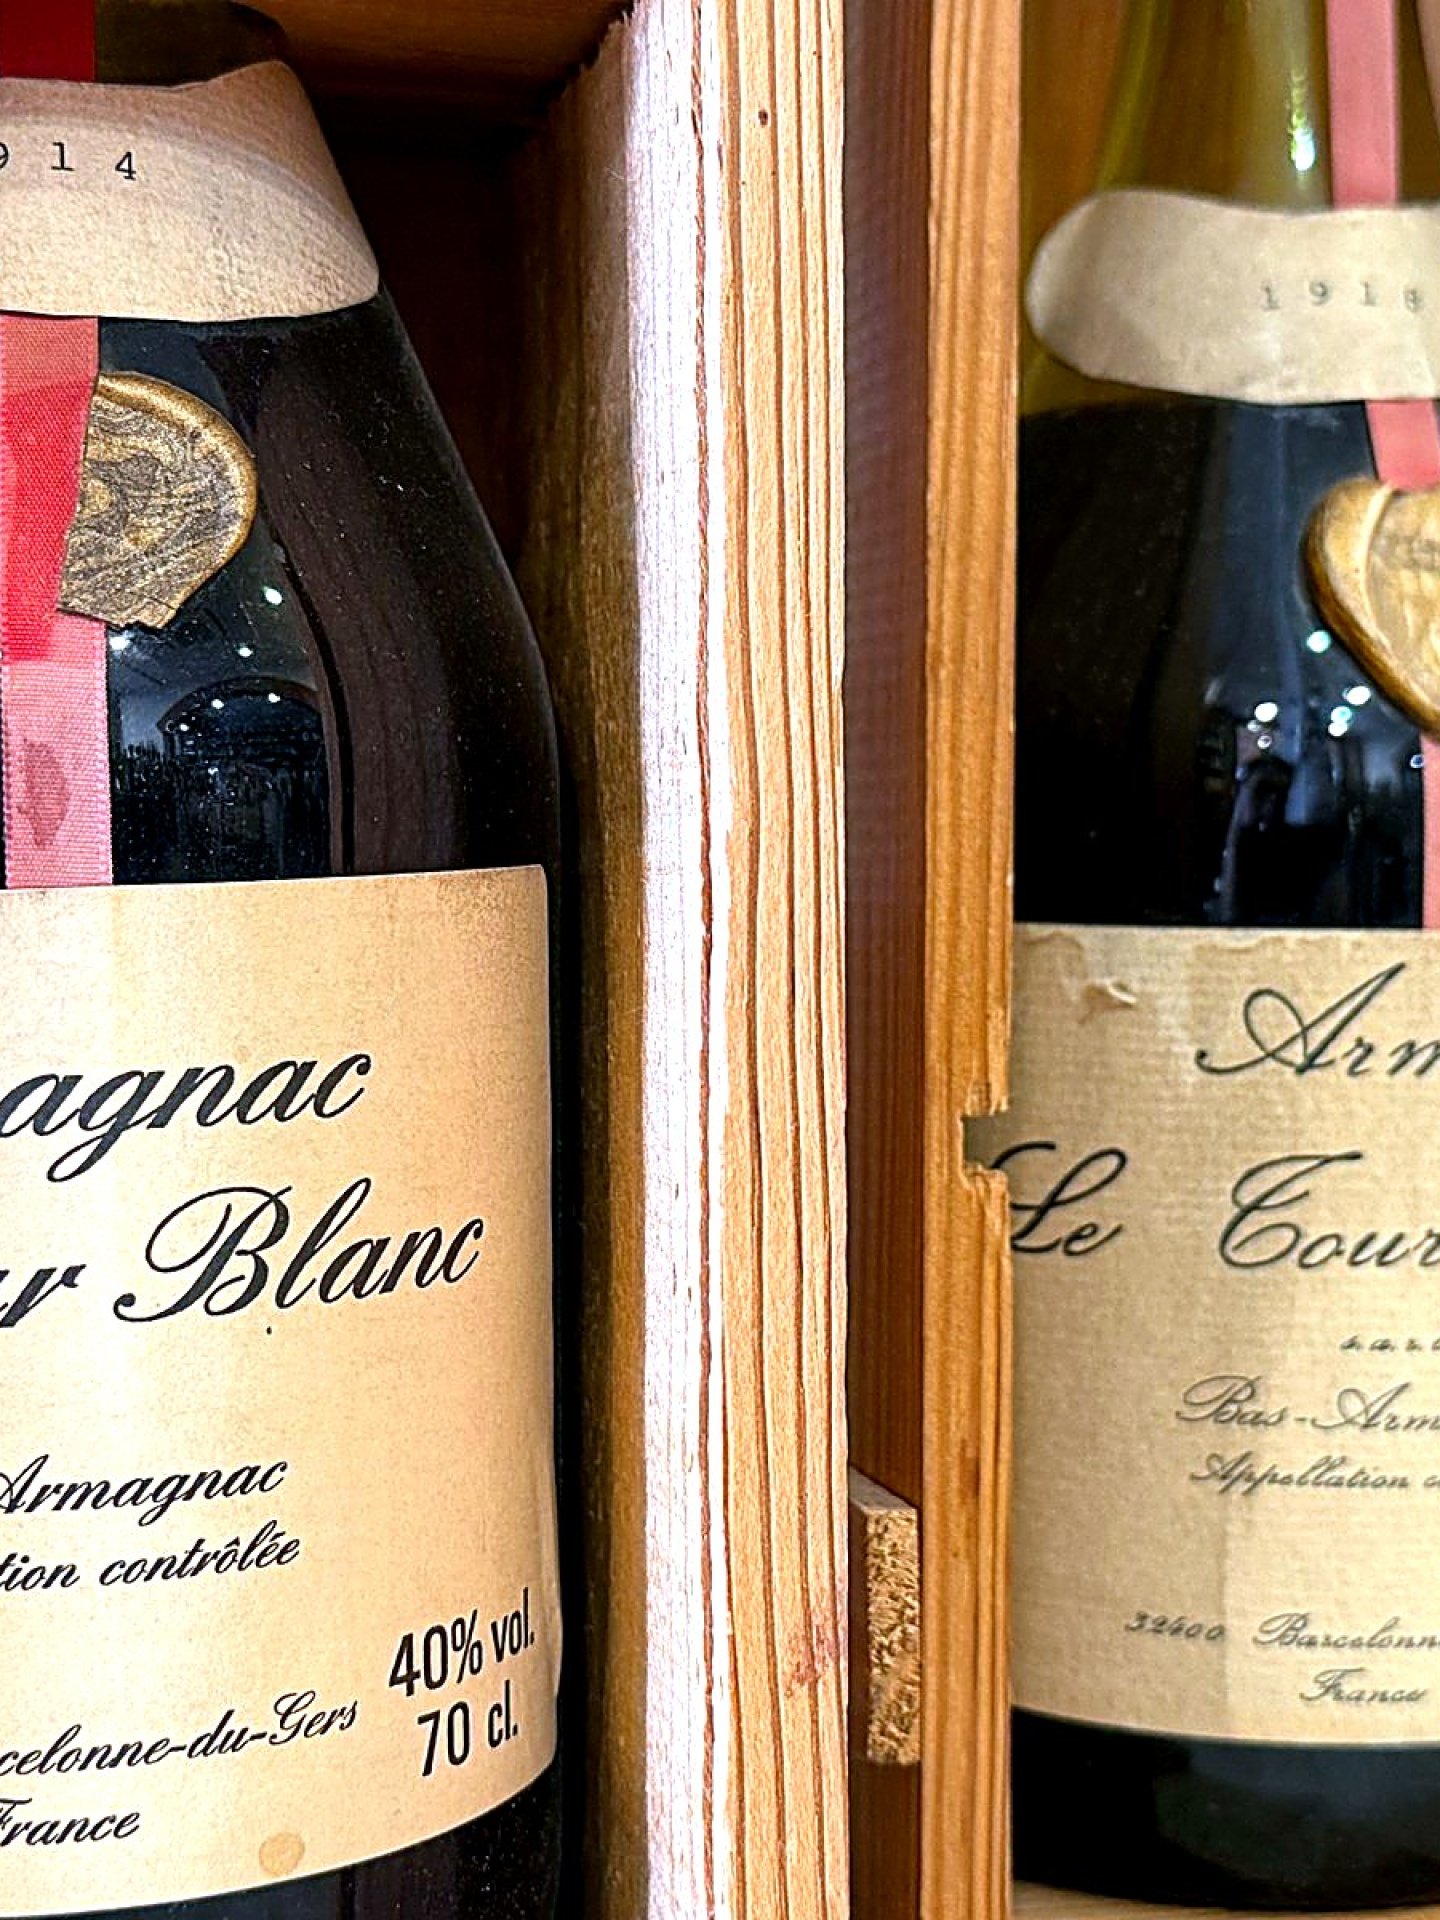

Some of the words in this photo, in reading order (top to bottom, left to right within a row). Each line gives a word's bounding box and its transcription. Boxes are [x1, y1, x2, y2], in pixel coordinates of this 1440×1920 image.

[113, 1178, 483, 1322] Blanc
[991, 1141, 1127, 1256] Le
[1219, 1152, 1440, 1268] Tour
[1189, 1451, 1409, 1496] Appellation
[99, 1520, 300, 1586] contrôlée
[389, 1609, 483, 1697] 40%
[491, 1587, 535, 1663] vol.
[1299, 1667, 1428, 1703] France
[0, 1691, 358, 1776] celonne-du-Gers
[417, 1701, 470, 1776] 70
[487, 1679, 518, 1748] cl.
